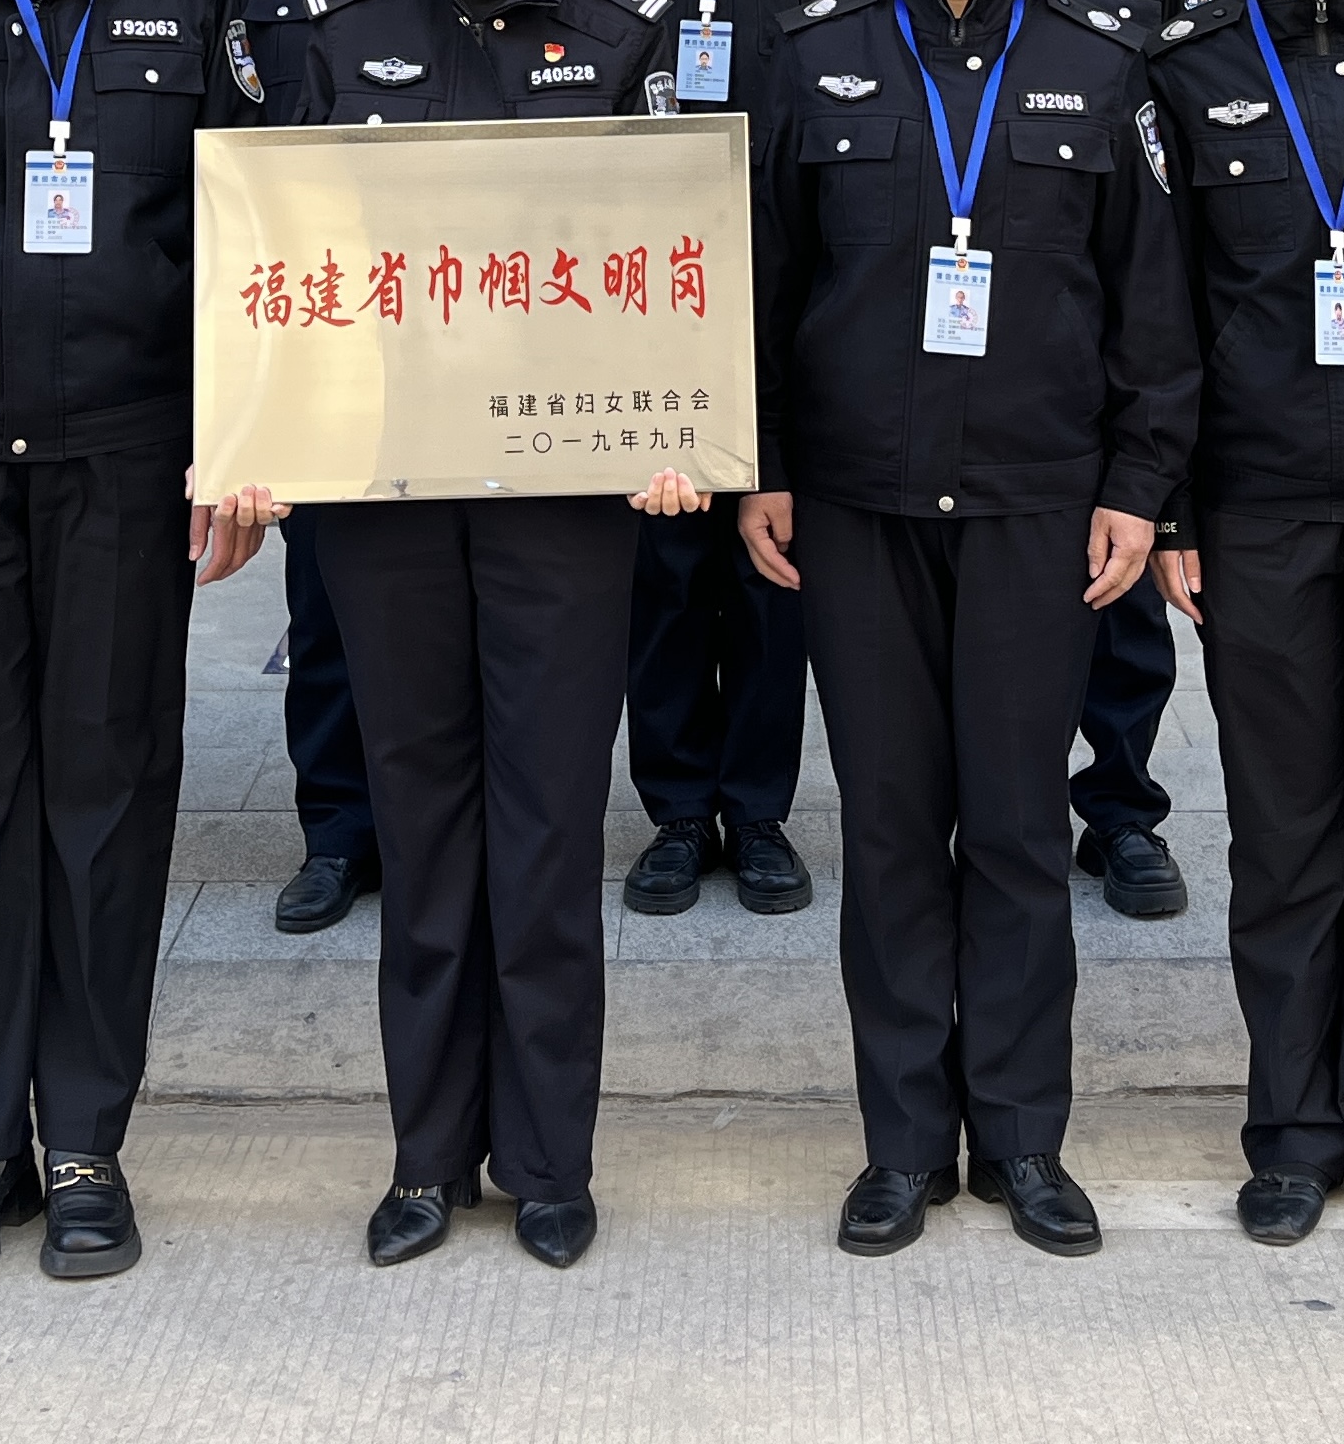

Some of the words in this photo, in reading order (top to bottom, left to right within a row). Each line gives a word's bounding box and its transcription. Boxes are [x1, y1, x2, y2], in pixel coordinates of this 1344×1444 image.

[111, 19, 179, 37] J92063
[530, 64, 596, 86] 540528
[1025, 92, 1084, 111] J92068
[238, 234, 707, 330] 福建省巾帼文明岗
[488, 387, 712, 419] 福建省妇女联合会
